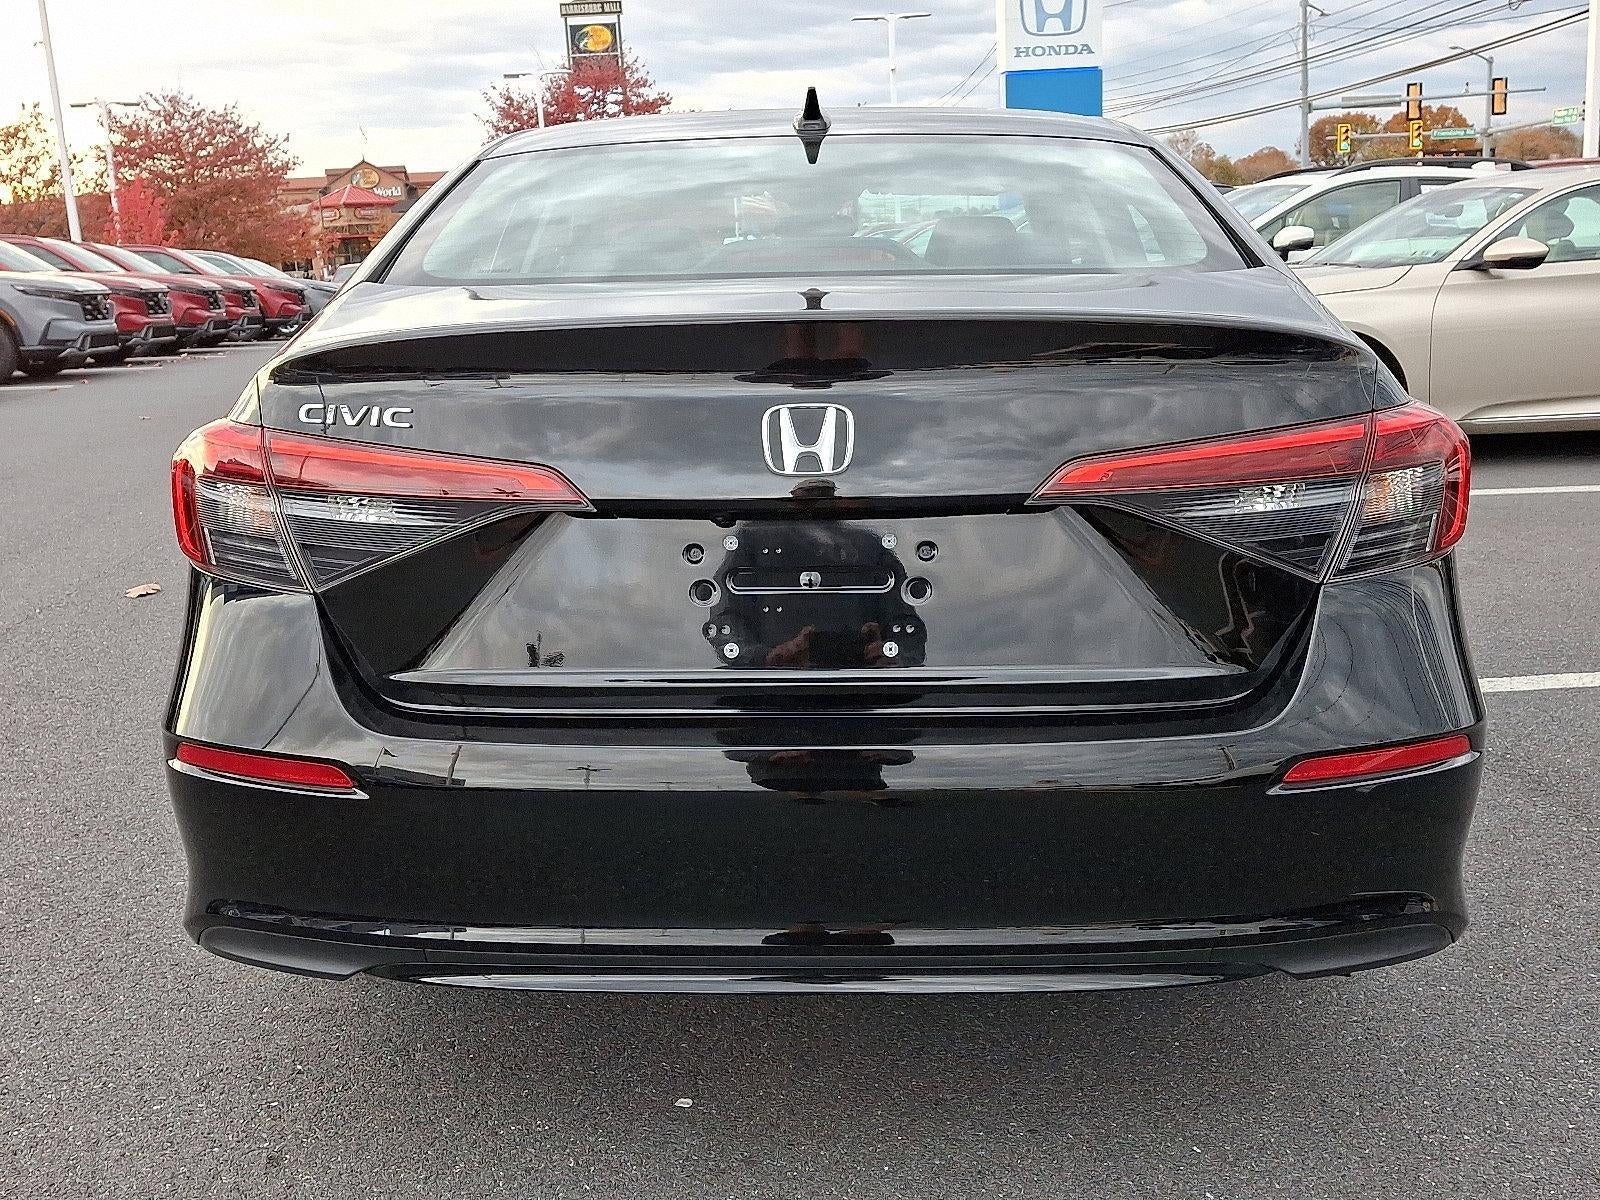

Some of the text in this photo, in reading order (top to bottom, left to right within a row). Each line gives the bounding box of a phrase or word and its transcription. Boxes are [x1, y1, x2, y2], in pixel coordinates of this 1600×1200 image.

[561, 2, 621, 14] HARRISBURG MALL
[1014, 44, 1094, 57] HONDA
[373, 186, 401, 197] World
[298, 403, 413, 428] CIVIC
